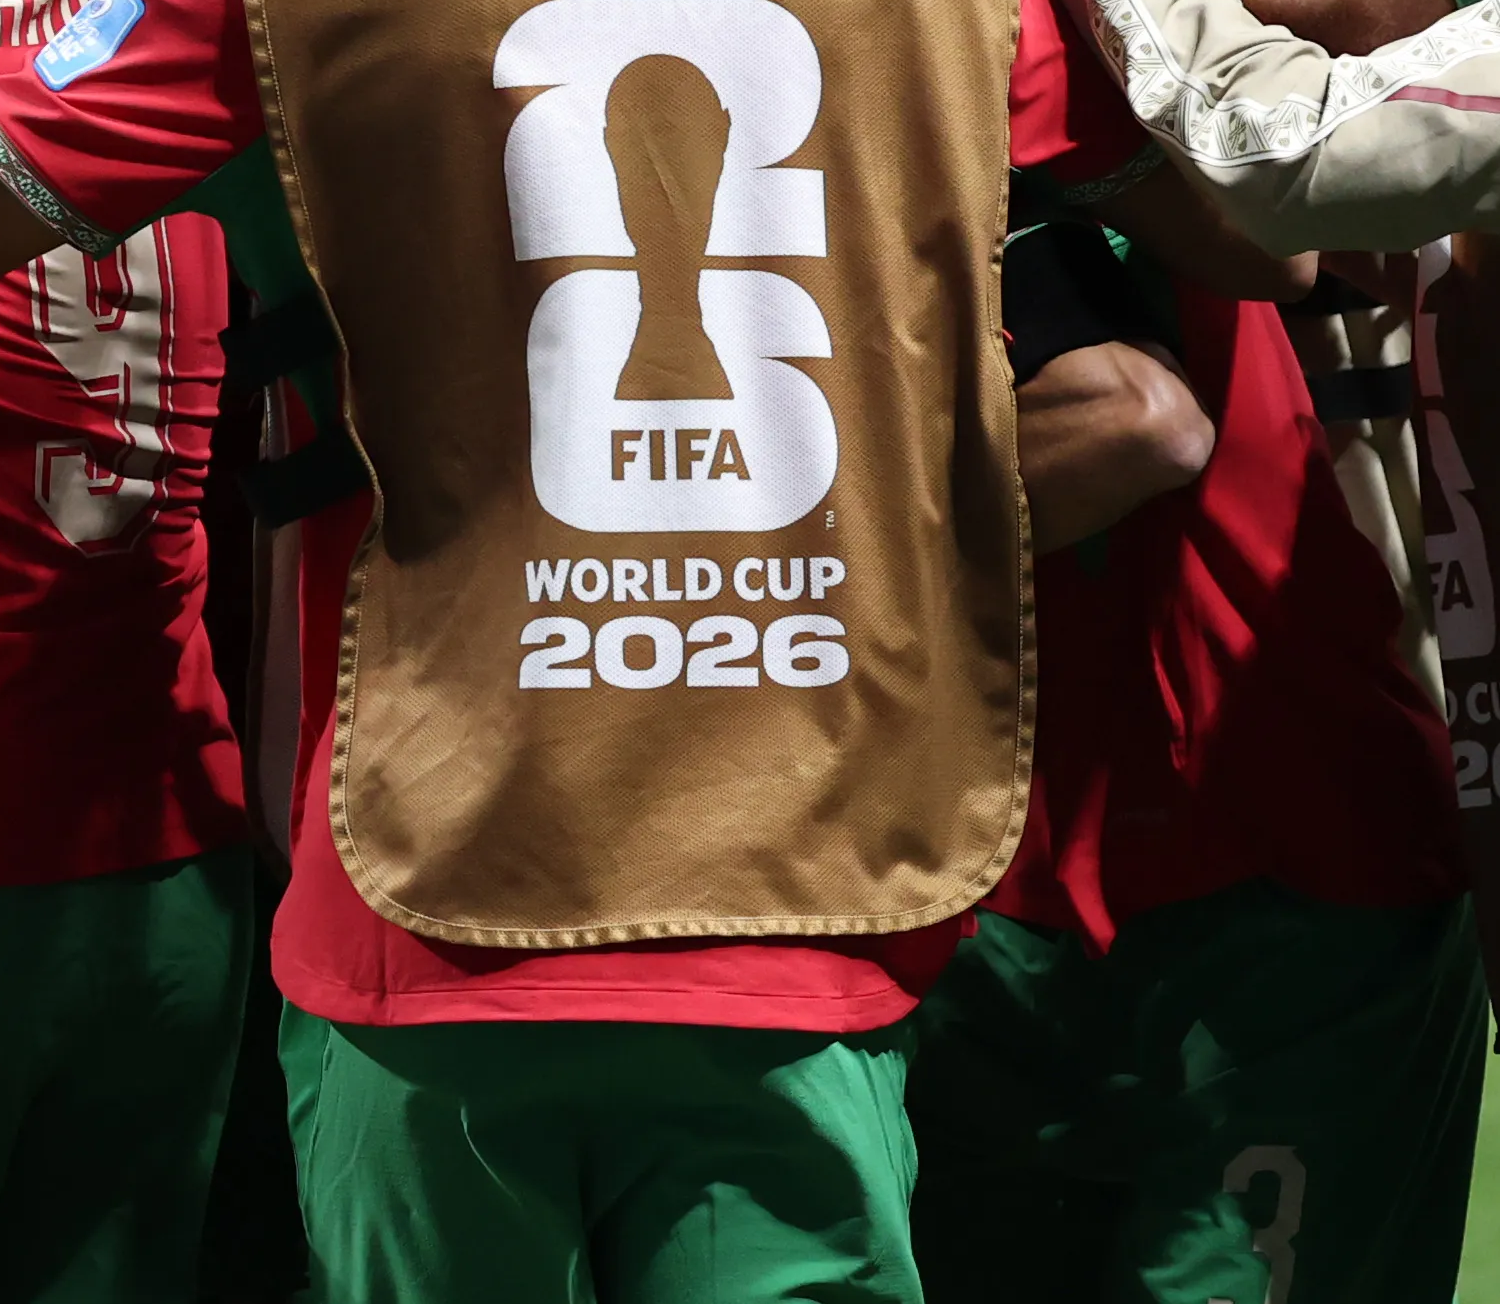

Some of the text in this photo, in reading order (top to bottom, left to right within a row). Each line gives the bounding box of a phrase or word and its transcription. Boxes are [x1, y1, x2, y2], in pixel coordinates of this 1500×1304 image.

[610, 429, 752, 481] FIFA
[525, 556, 847, 603] WORLD CUP
[519, 614, 851, 690] 2026
